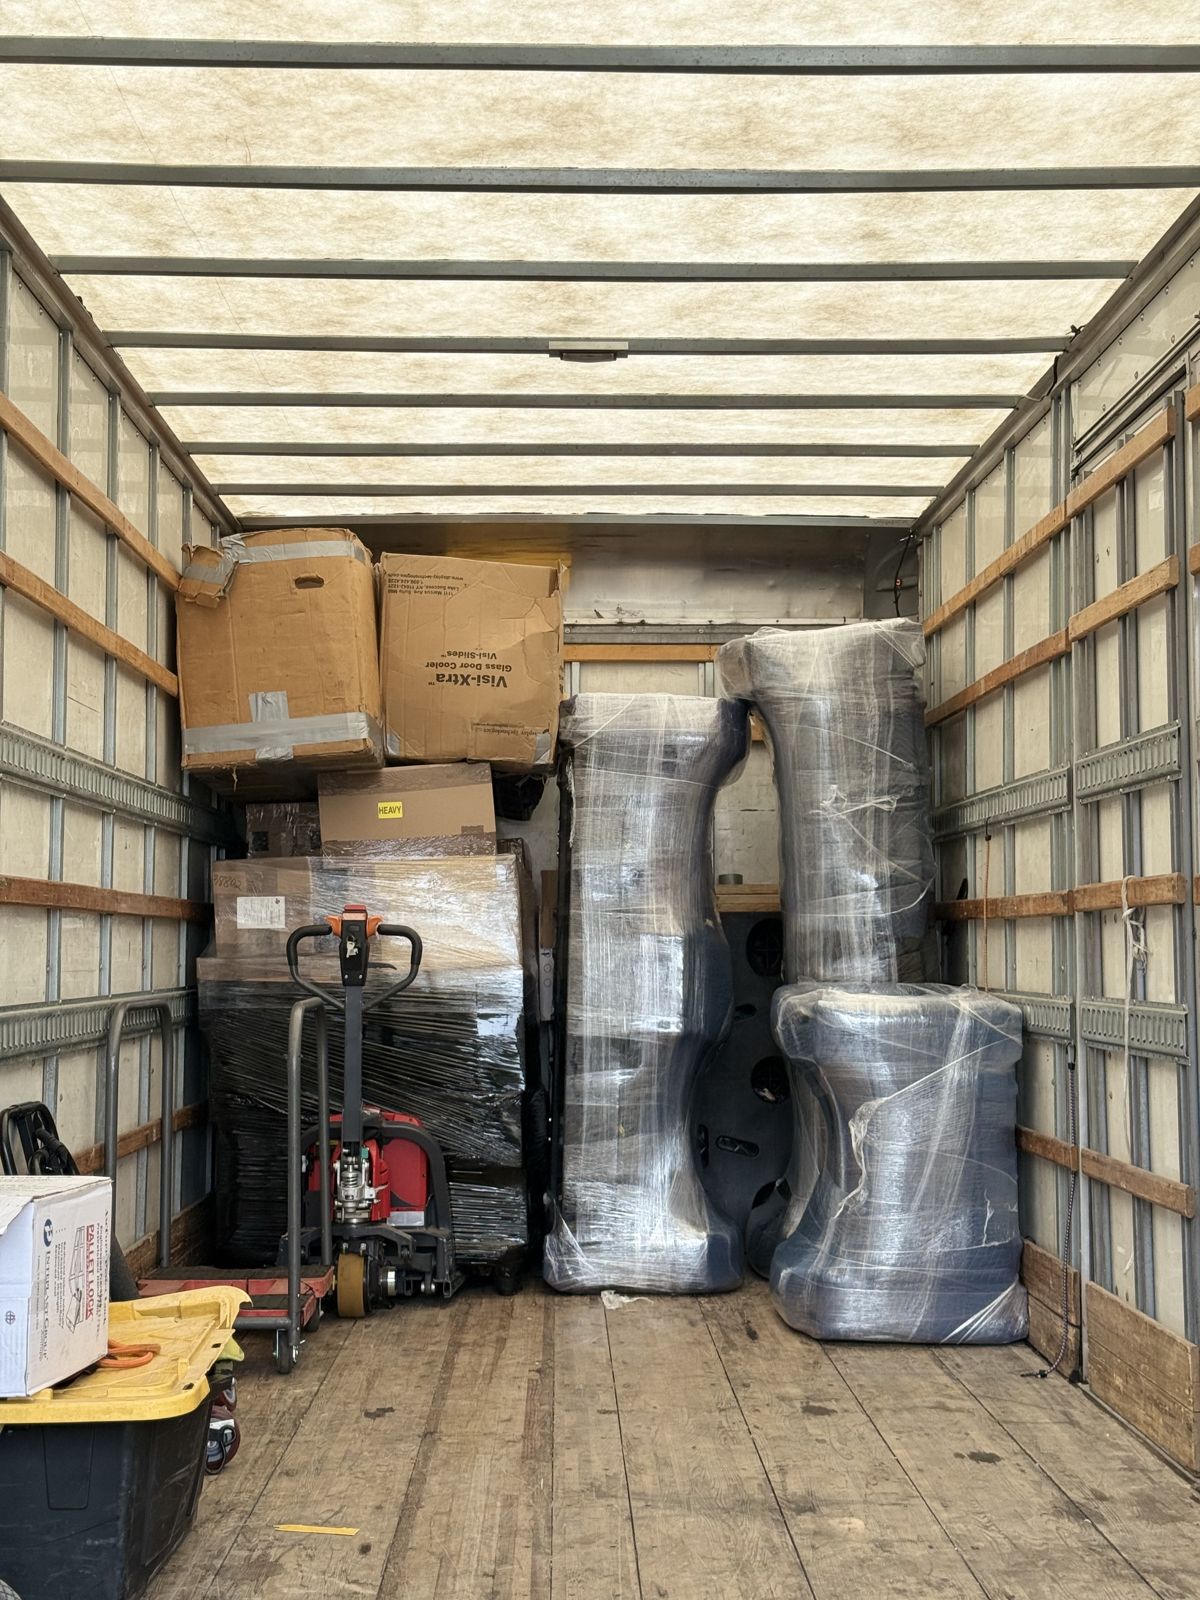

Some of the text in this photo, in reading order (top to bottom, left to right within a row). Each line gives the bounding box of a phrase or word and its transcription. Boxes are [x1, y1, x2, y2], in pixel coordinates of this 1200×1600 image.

[425, 661, 512, 672] Glass Door Cooler
[378, 806, 402, 815] HEAVY
